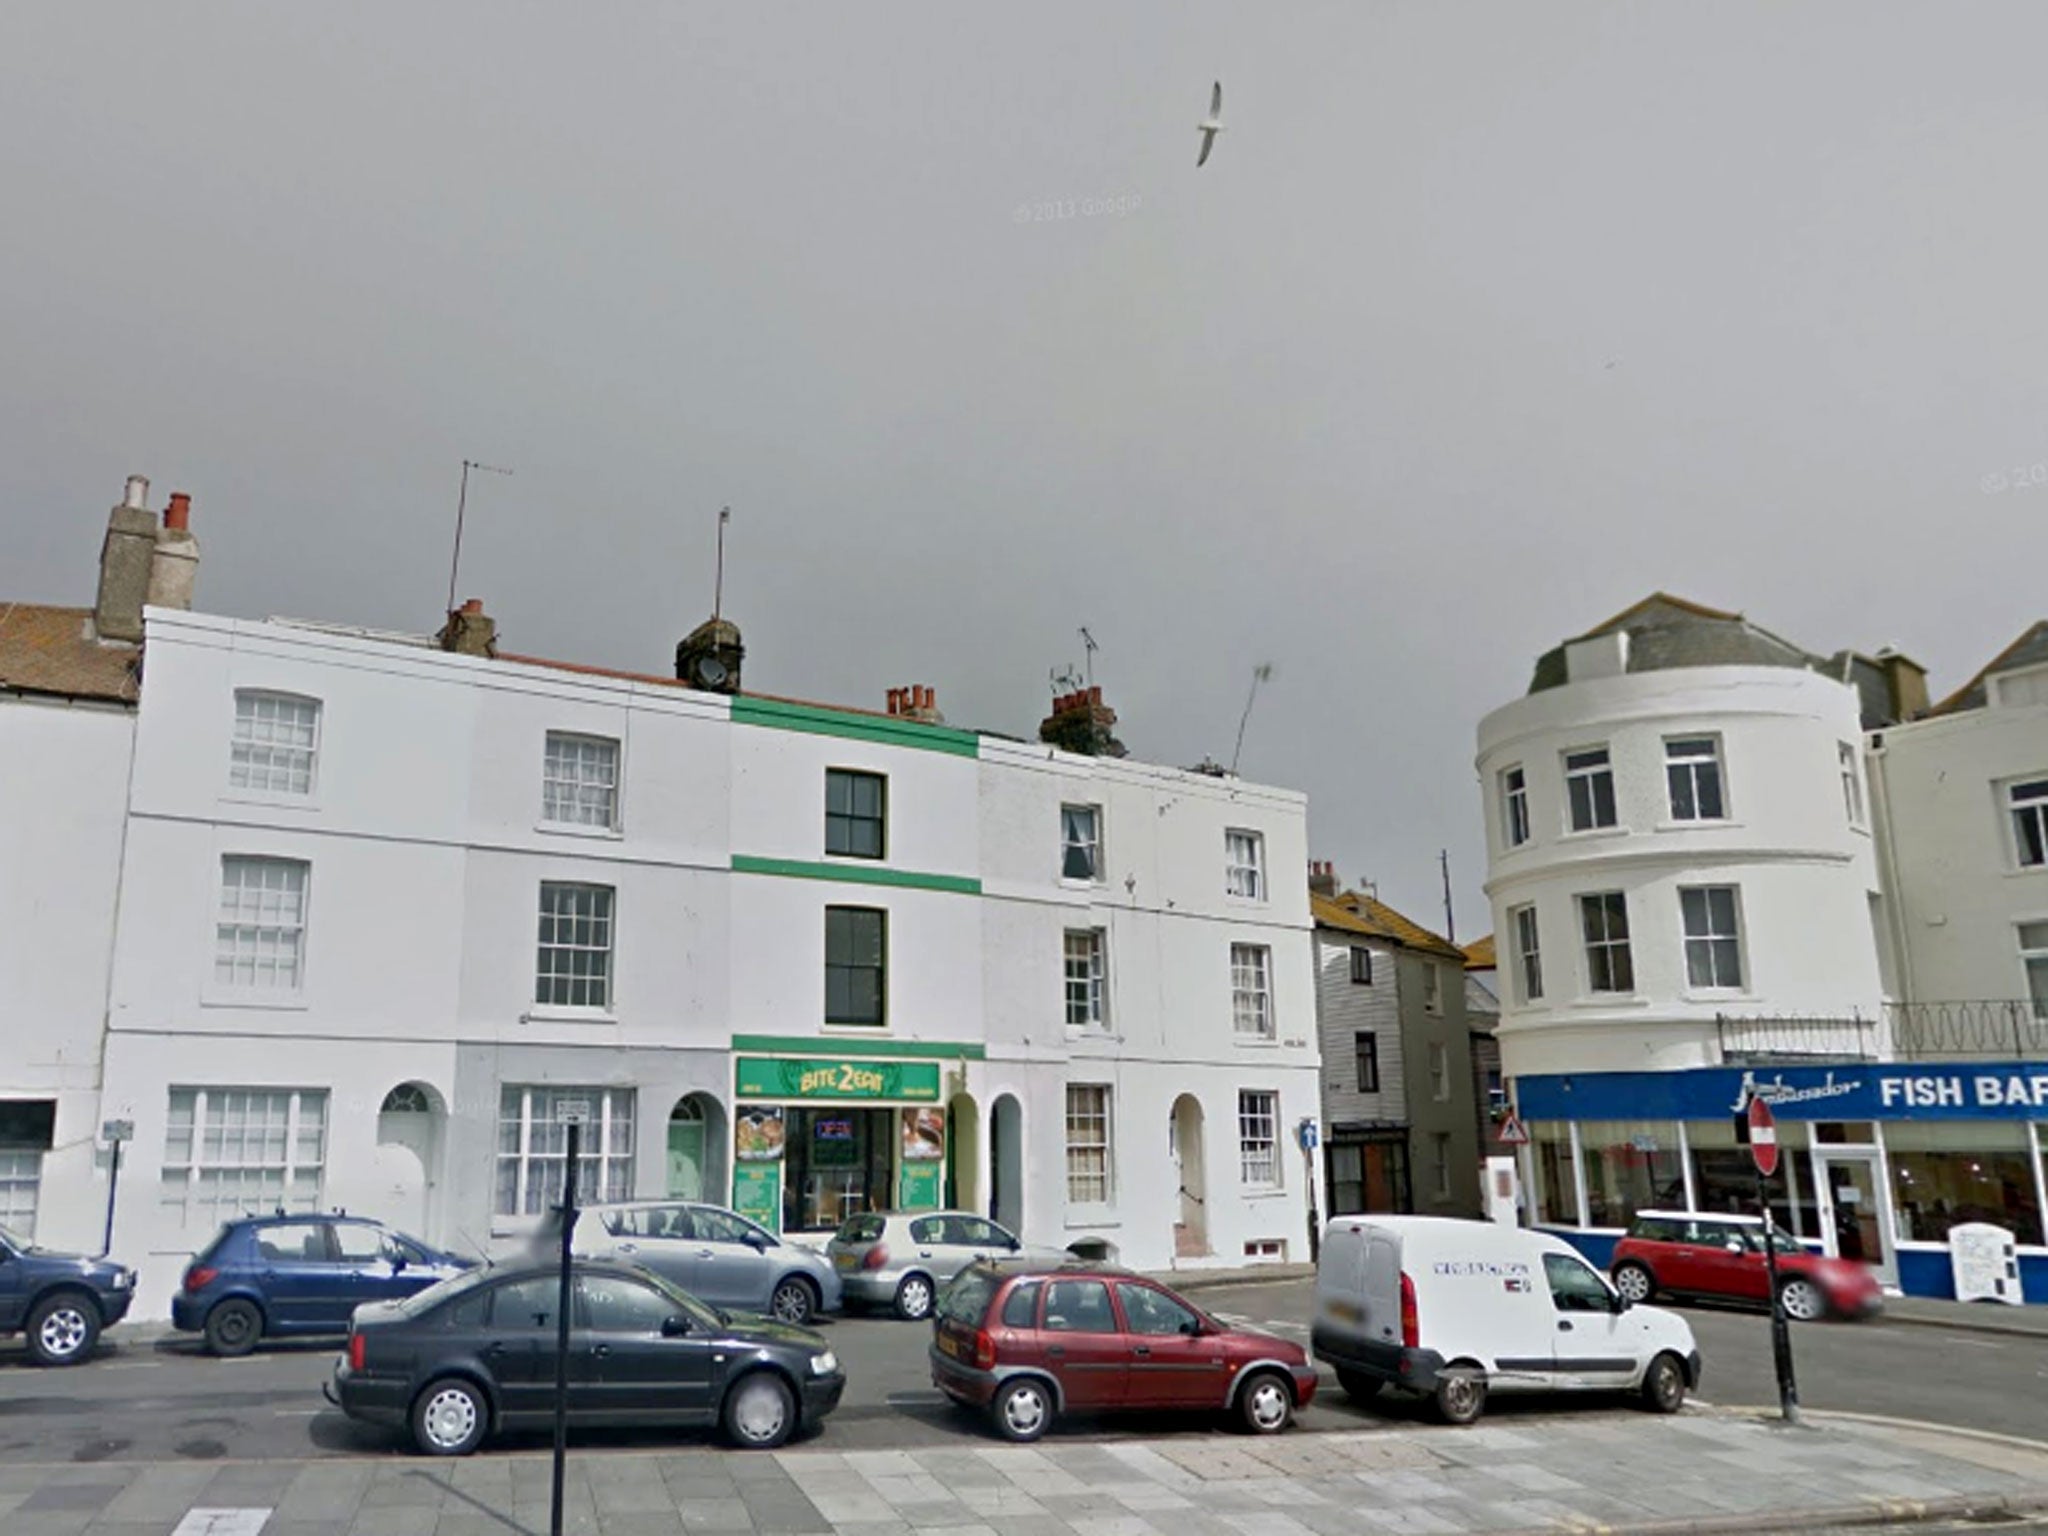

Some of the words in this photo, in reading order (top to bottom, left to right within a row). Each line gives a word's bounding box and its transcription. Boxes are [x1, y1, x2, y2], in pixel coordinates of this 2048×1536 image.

[800, 1068, 837, 1092] BITE
[837, 1064, 854, 1091] 2
[1880, 1077, 1964, 1106] FISH
